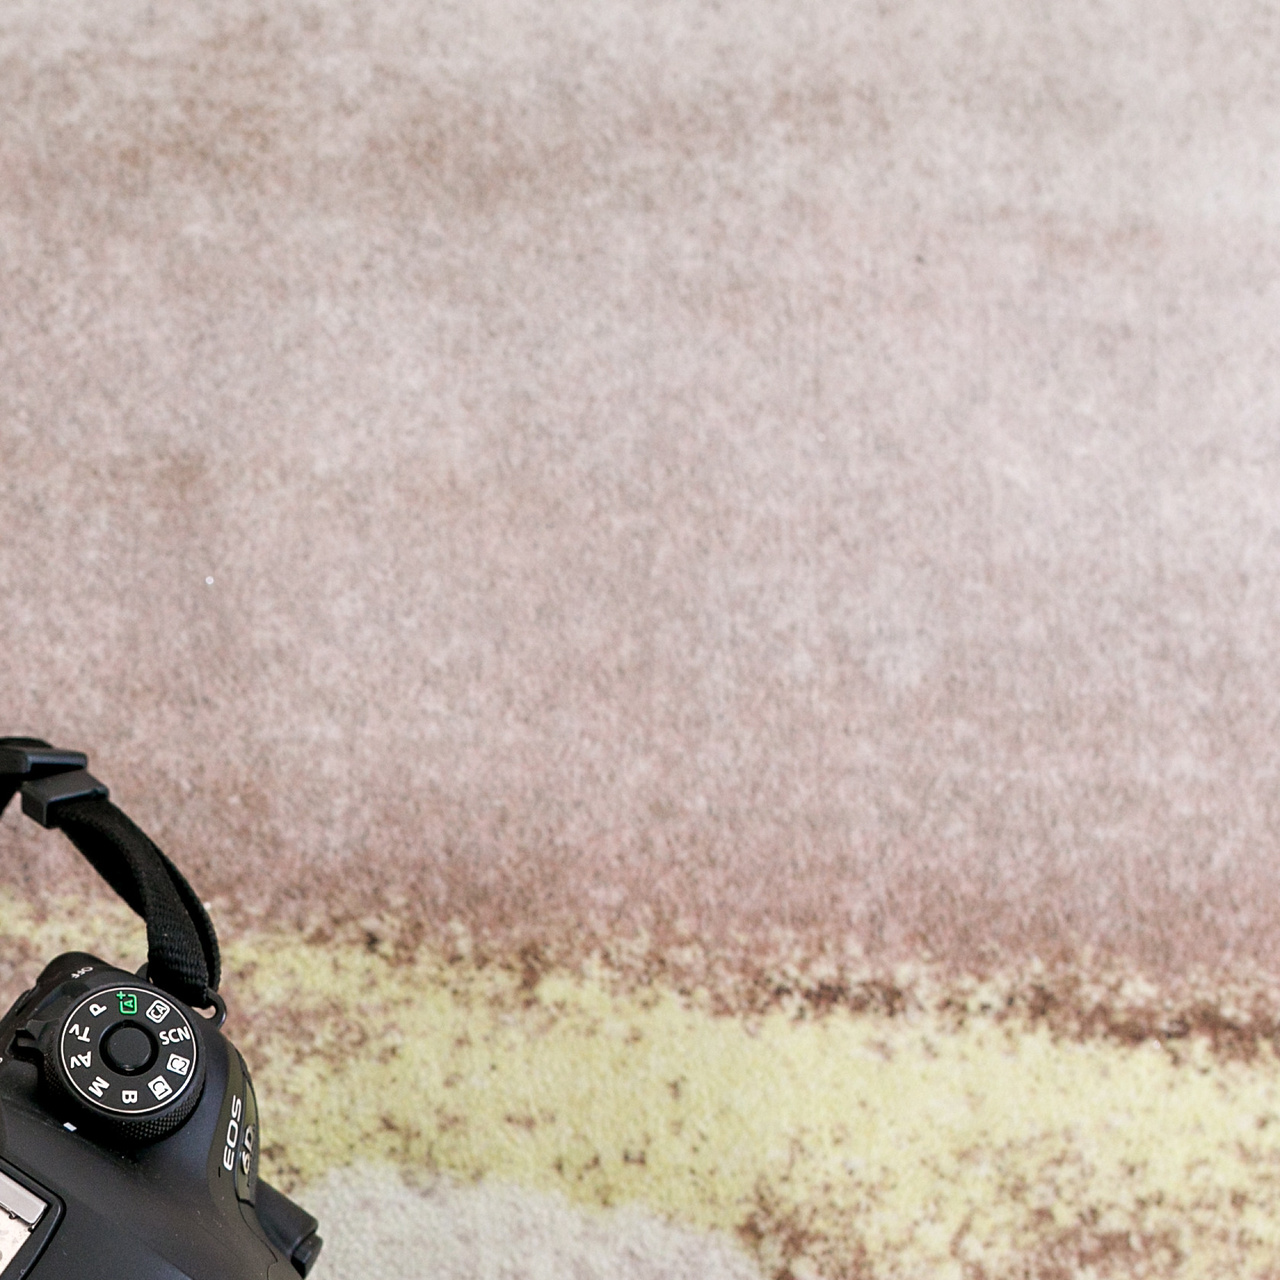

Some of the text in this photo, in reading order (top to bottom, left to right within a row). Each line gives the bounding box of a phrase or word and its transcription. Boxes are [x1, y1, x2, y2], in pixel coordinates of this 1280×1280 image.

[71, 966, 94, 979] OFF
[89, 1003, 108, 1017] P
[147, 1002, 169, 1021] CA
[69, 1024, 91, 1043] Tv
[159, 1026, 191, 1045] SCN
[70, 1051, 92, 1069] Av
[169, 1057, 189, 1074] C2
[88, 1076, 110, 1098] M
[122, 1089, 138, 1104] B
[150, 1077, 171, 1098] C1
[223, 1094, 242, 1171] EOS
